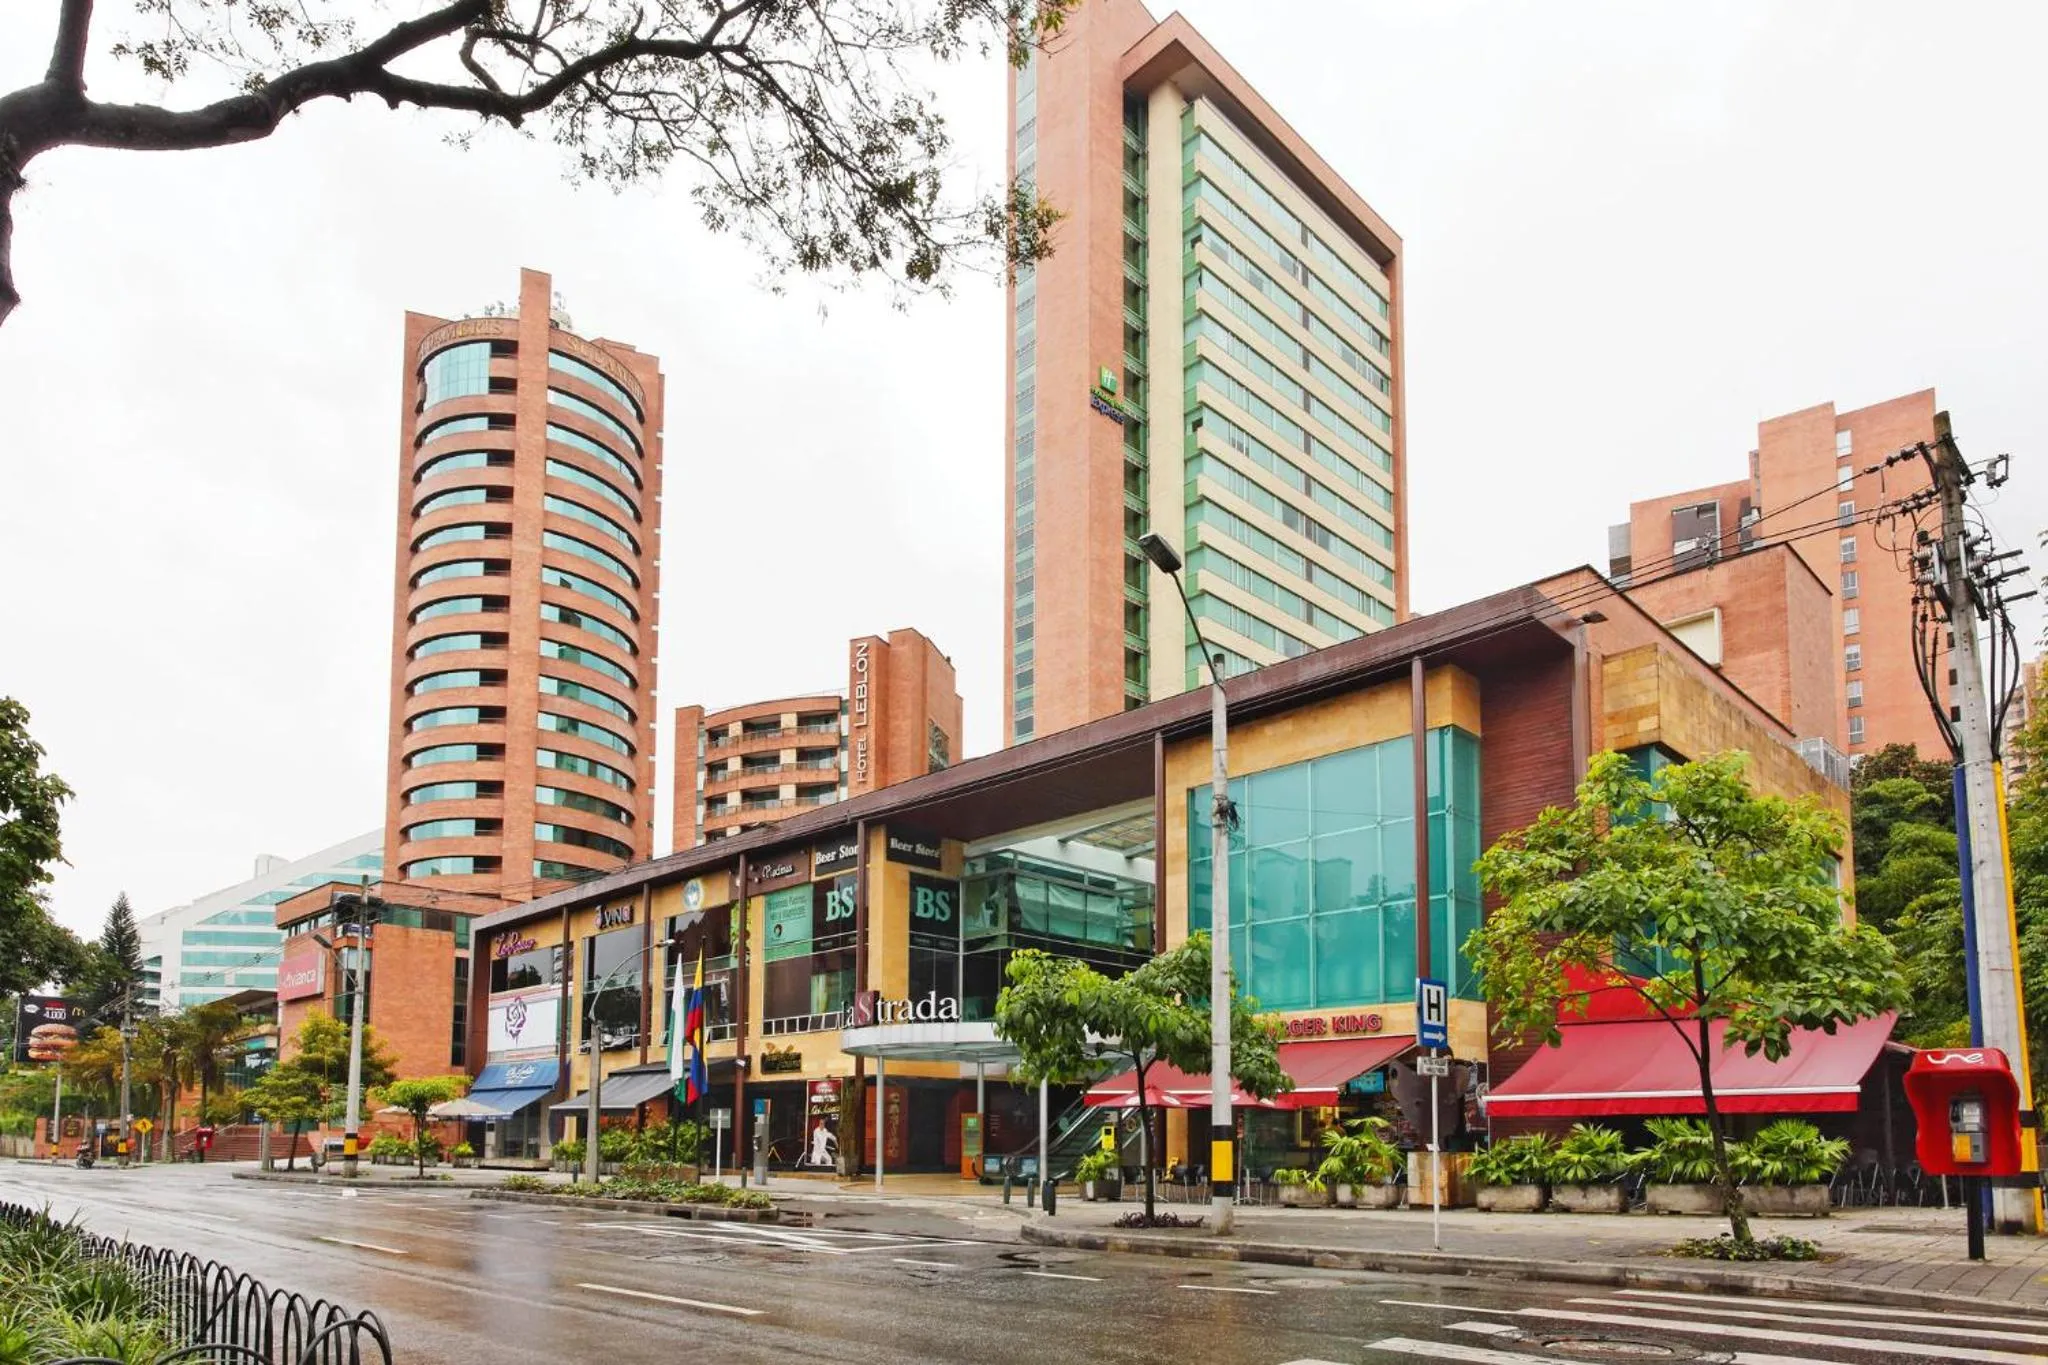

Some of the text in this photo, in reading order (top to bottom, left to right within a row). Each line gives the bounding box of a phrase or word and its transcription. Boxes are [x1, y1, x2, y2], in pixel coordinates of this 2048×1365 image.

[857, 734, 868, 783] HOTEL
[815, 844, 858, 865] Beer Stor
[890, 837, 914, 852] Beer
[825, 886, 856, 922] BS
[915, 886, 951, 922] BS
[1427, 988, 1441, 1023] H
[1331, 1013, 1383, 1034] KING
